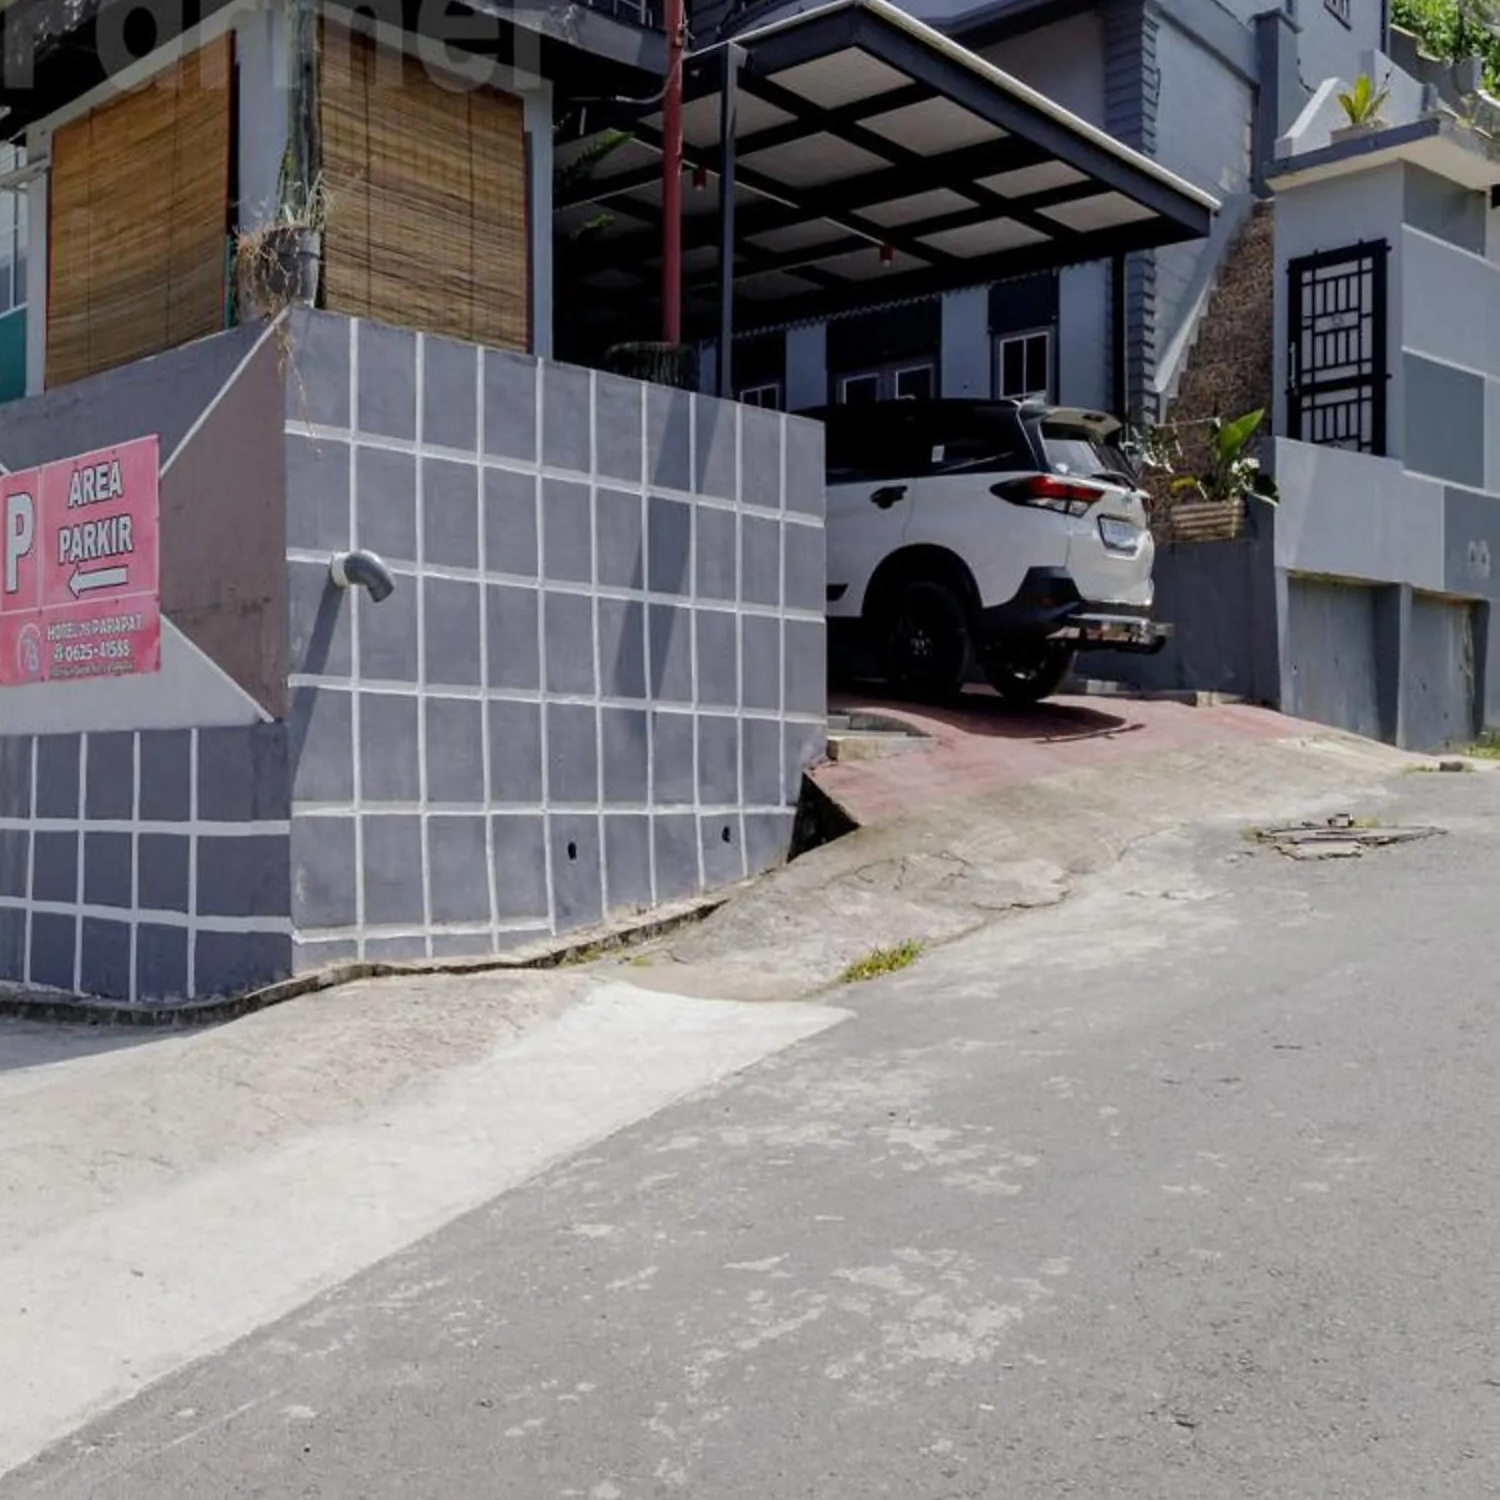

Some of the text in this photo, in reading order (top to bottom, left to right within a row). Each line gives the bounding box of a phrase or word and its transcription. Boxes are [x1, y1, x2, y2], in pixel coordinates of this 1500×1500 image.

[68, 458, 123, 508] AREA
[4, 491, 34, 593] P
[57, 513, 133, 565] PARKIR
